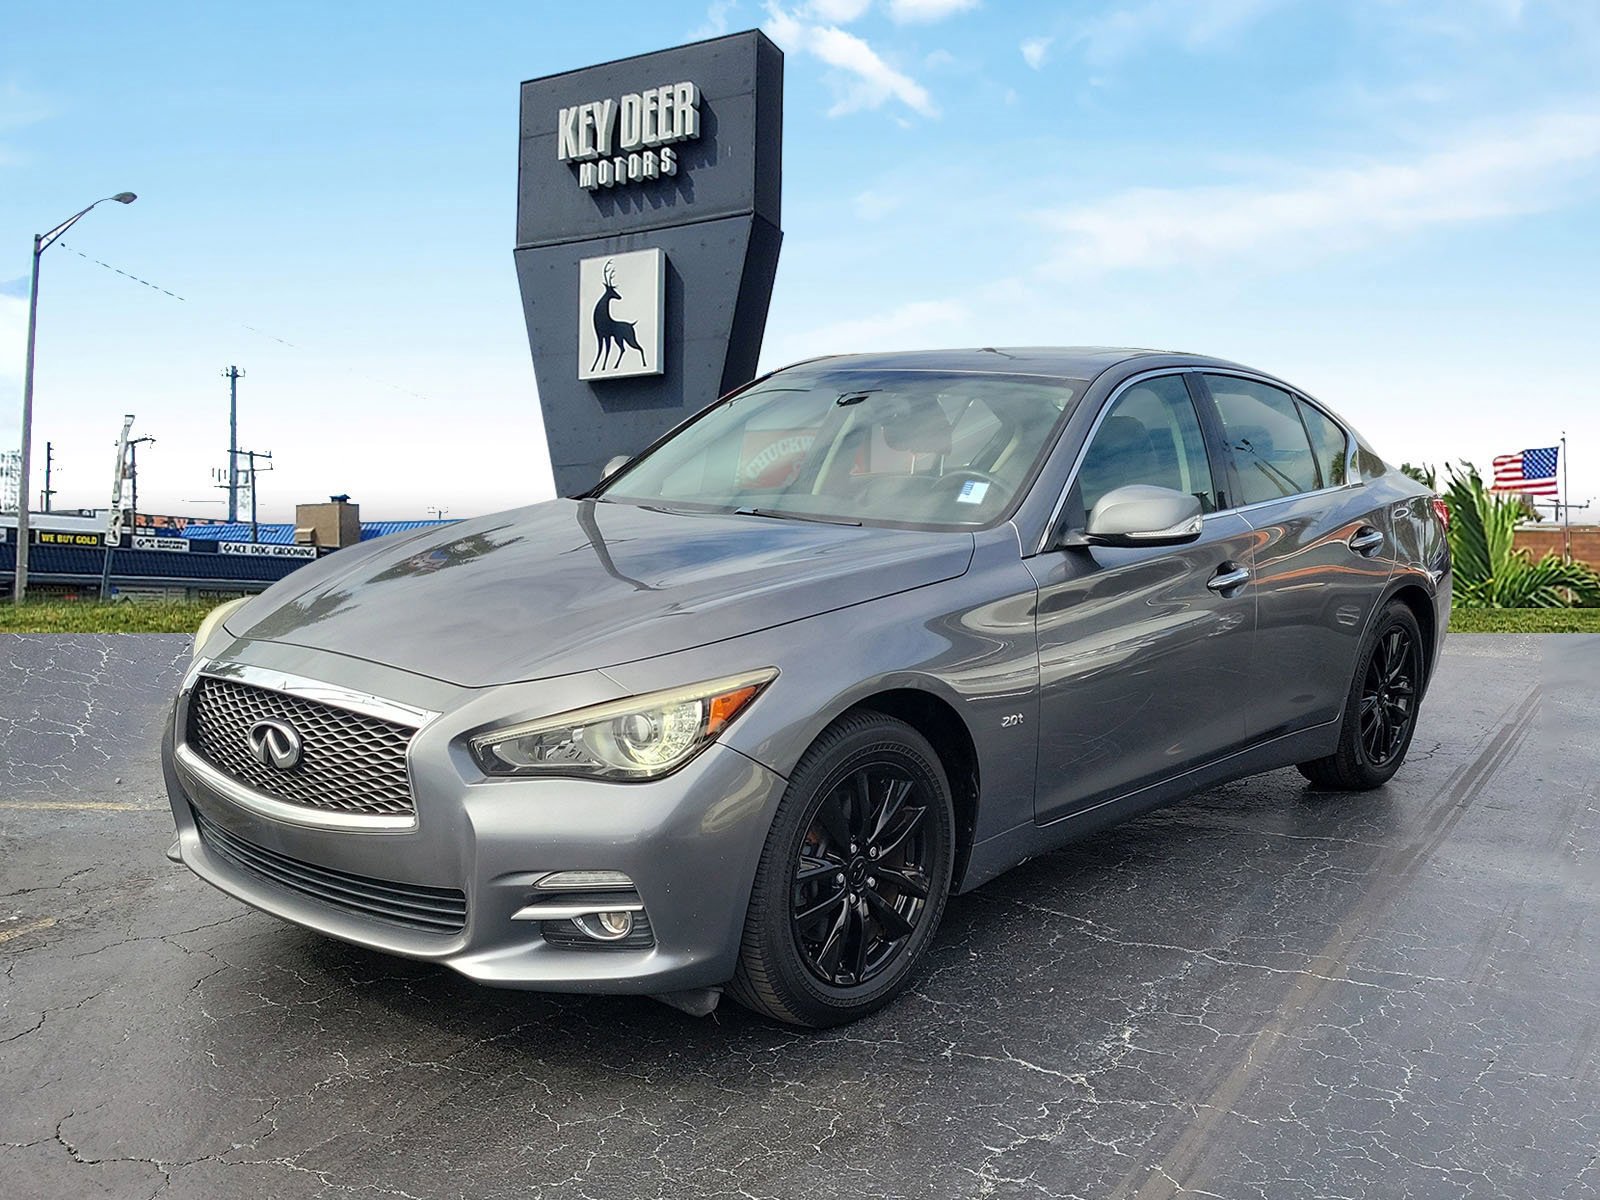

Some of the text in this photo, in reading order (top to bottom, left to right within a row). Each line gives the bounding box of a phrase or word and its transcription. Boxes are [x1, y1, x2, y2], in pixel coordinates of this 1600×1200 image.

[557, 81, 701, 161] KEY DEER
[579, 146, 678, 191] MOTORS
[41, 533, 97, 545] WE BUY GOLD
[233, 545, 314, 557] ACE DOG GROOMING
